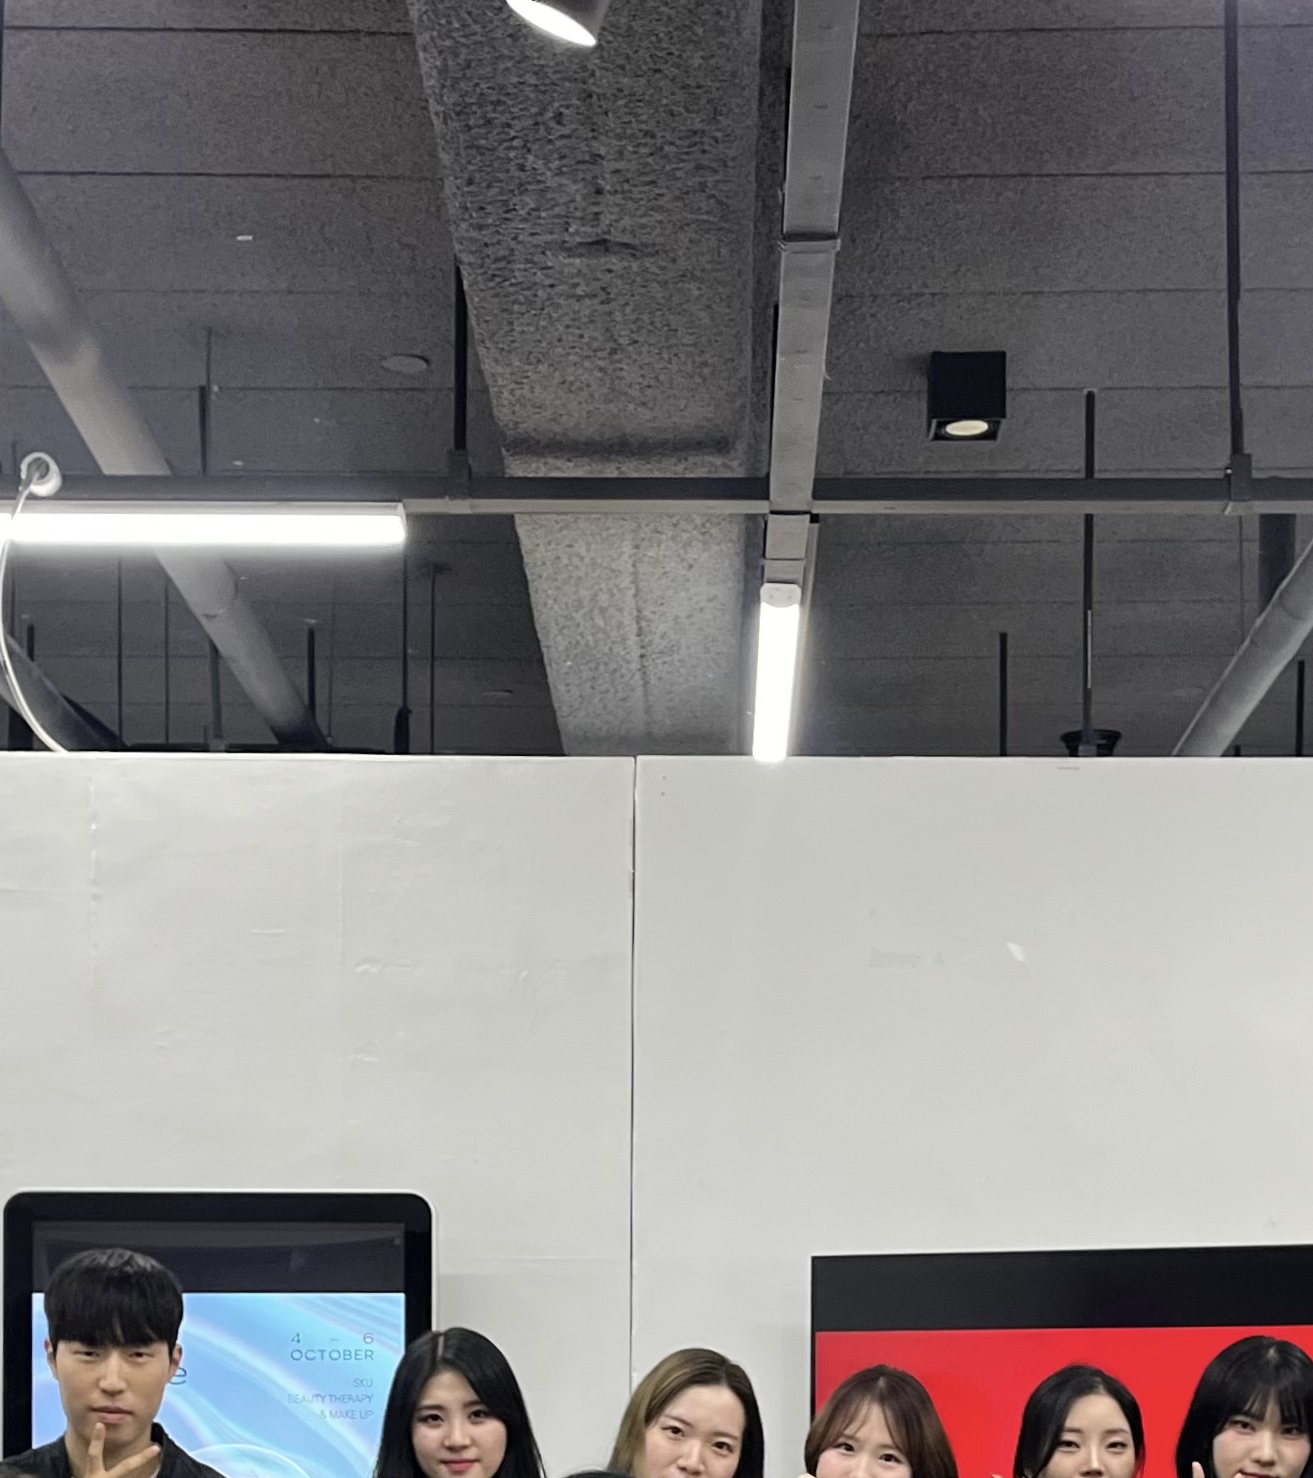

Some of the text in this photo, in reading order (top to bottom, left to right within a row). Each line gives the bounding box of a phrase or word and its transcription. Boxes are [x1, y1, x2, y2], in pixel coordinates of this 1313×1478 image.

[290, 1332, 301, 1344] 4
[363, 1332, 374, 1345] 6
[290, 1349, 374, 1361] OCTOBER
[353, 1378, 374, 1388] SKU
[287, 1393, 374, 1404] BEAUTY THERAPY
[329, 1409, 358, 1420] MAKE
[359, 1409, 374, 1420] UP
